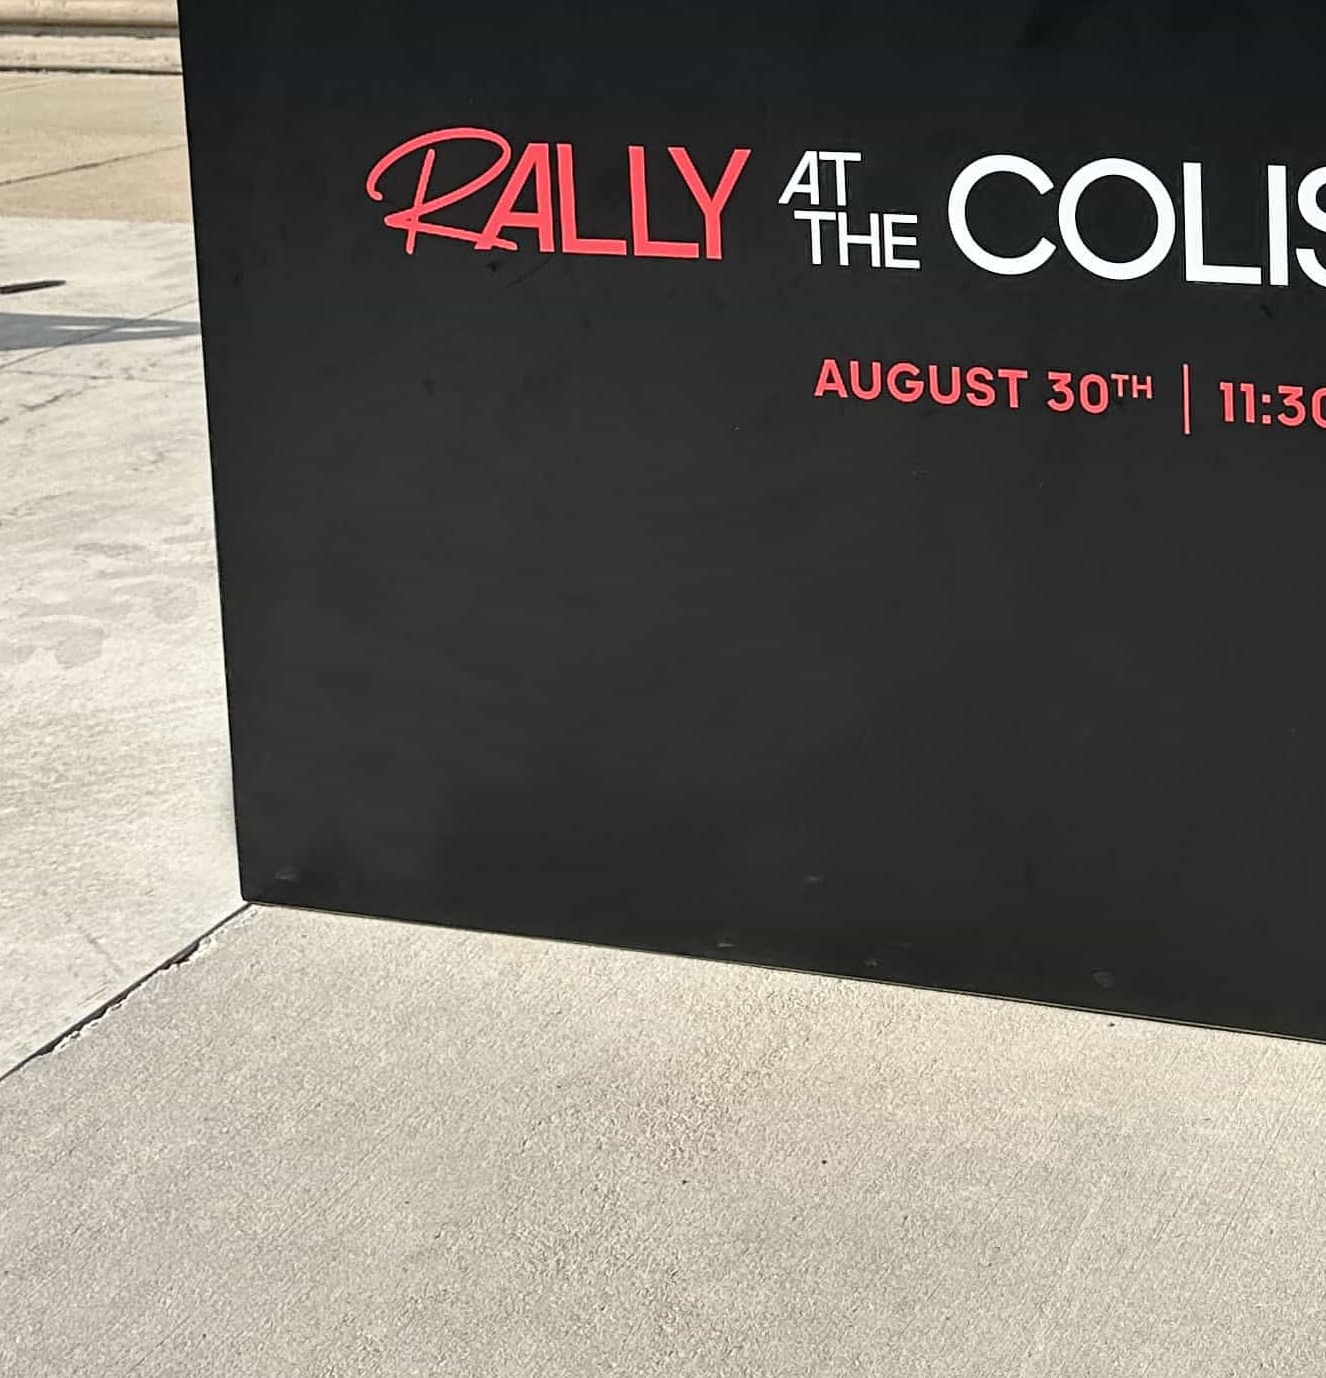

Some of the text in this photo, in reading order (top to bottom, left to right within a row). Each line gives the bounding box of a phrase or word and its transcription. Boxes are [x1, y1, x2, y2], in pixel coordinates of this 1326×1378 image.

[366, 128, 751, 259] RALLY
[778, 150, 862, 207] AT
[793, 210, 921, 270] THE
[814, 358, 1153, 414] AUGUST 30TH
